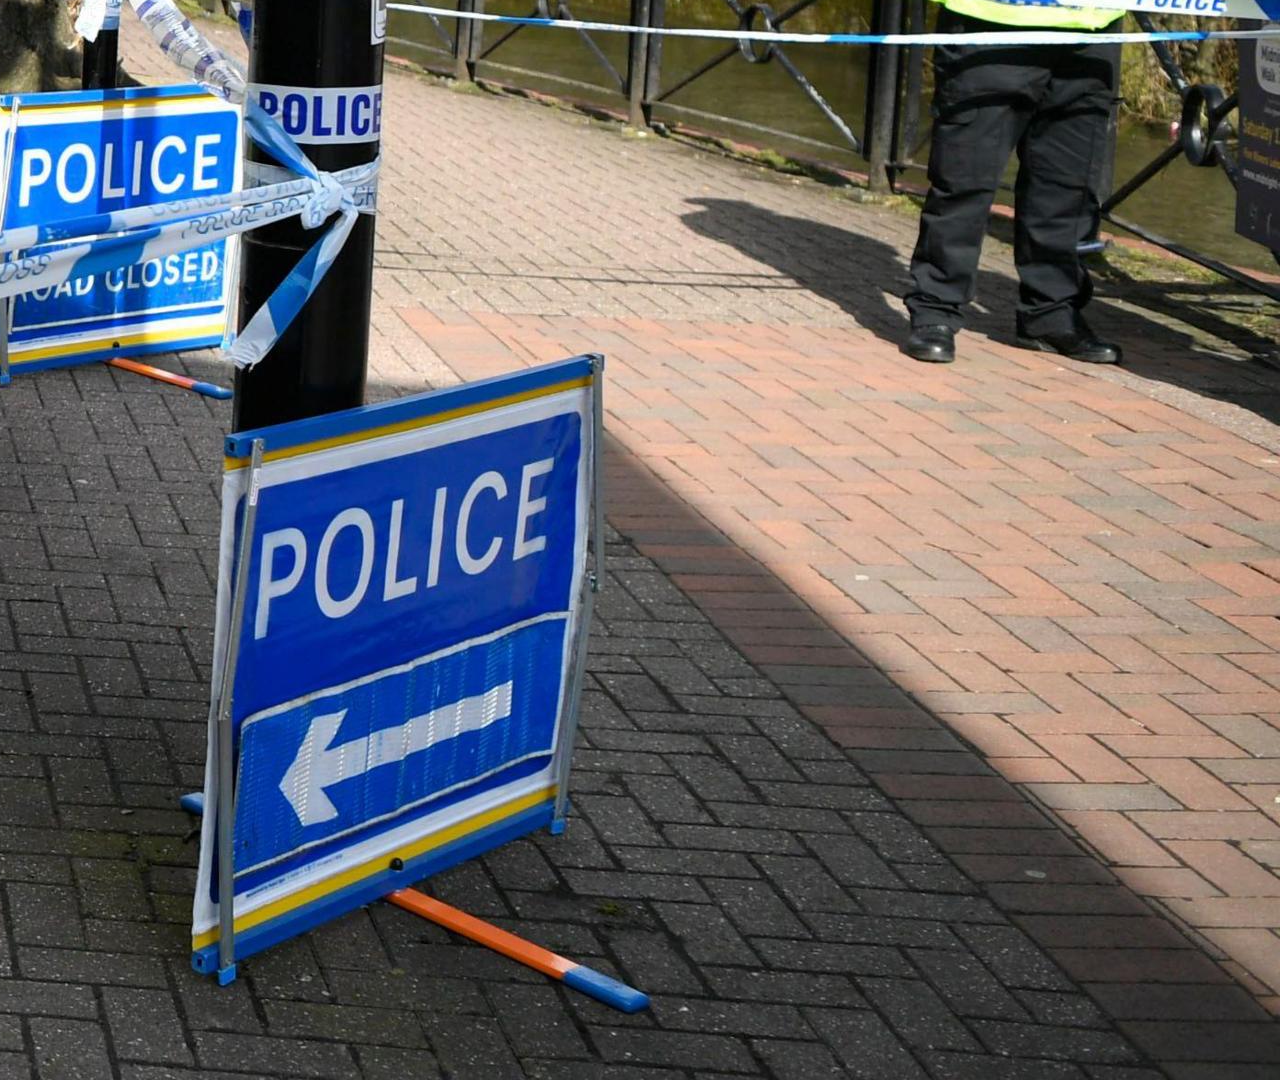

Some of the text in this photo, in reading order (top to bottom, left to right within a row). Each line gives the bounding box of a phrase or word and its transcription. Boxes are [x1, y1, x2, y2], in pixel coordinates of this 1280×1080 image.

[259, 91, 382, 137] POLICE
[18, 133, 222, 208] POLICE
[104, 250, 219, 293] CLOSED
[254, 457, 555, 640] POLICE
